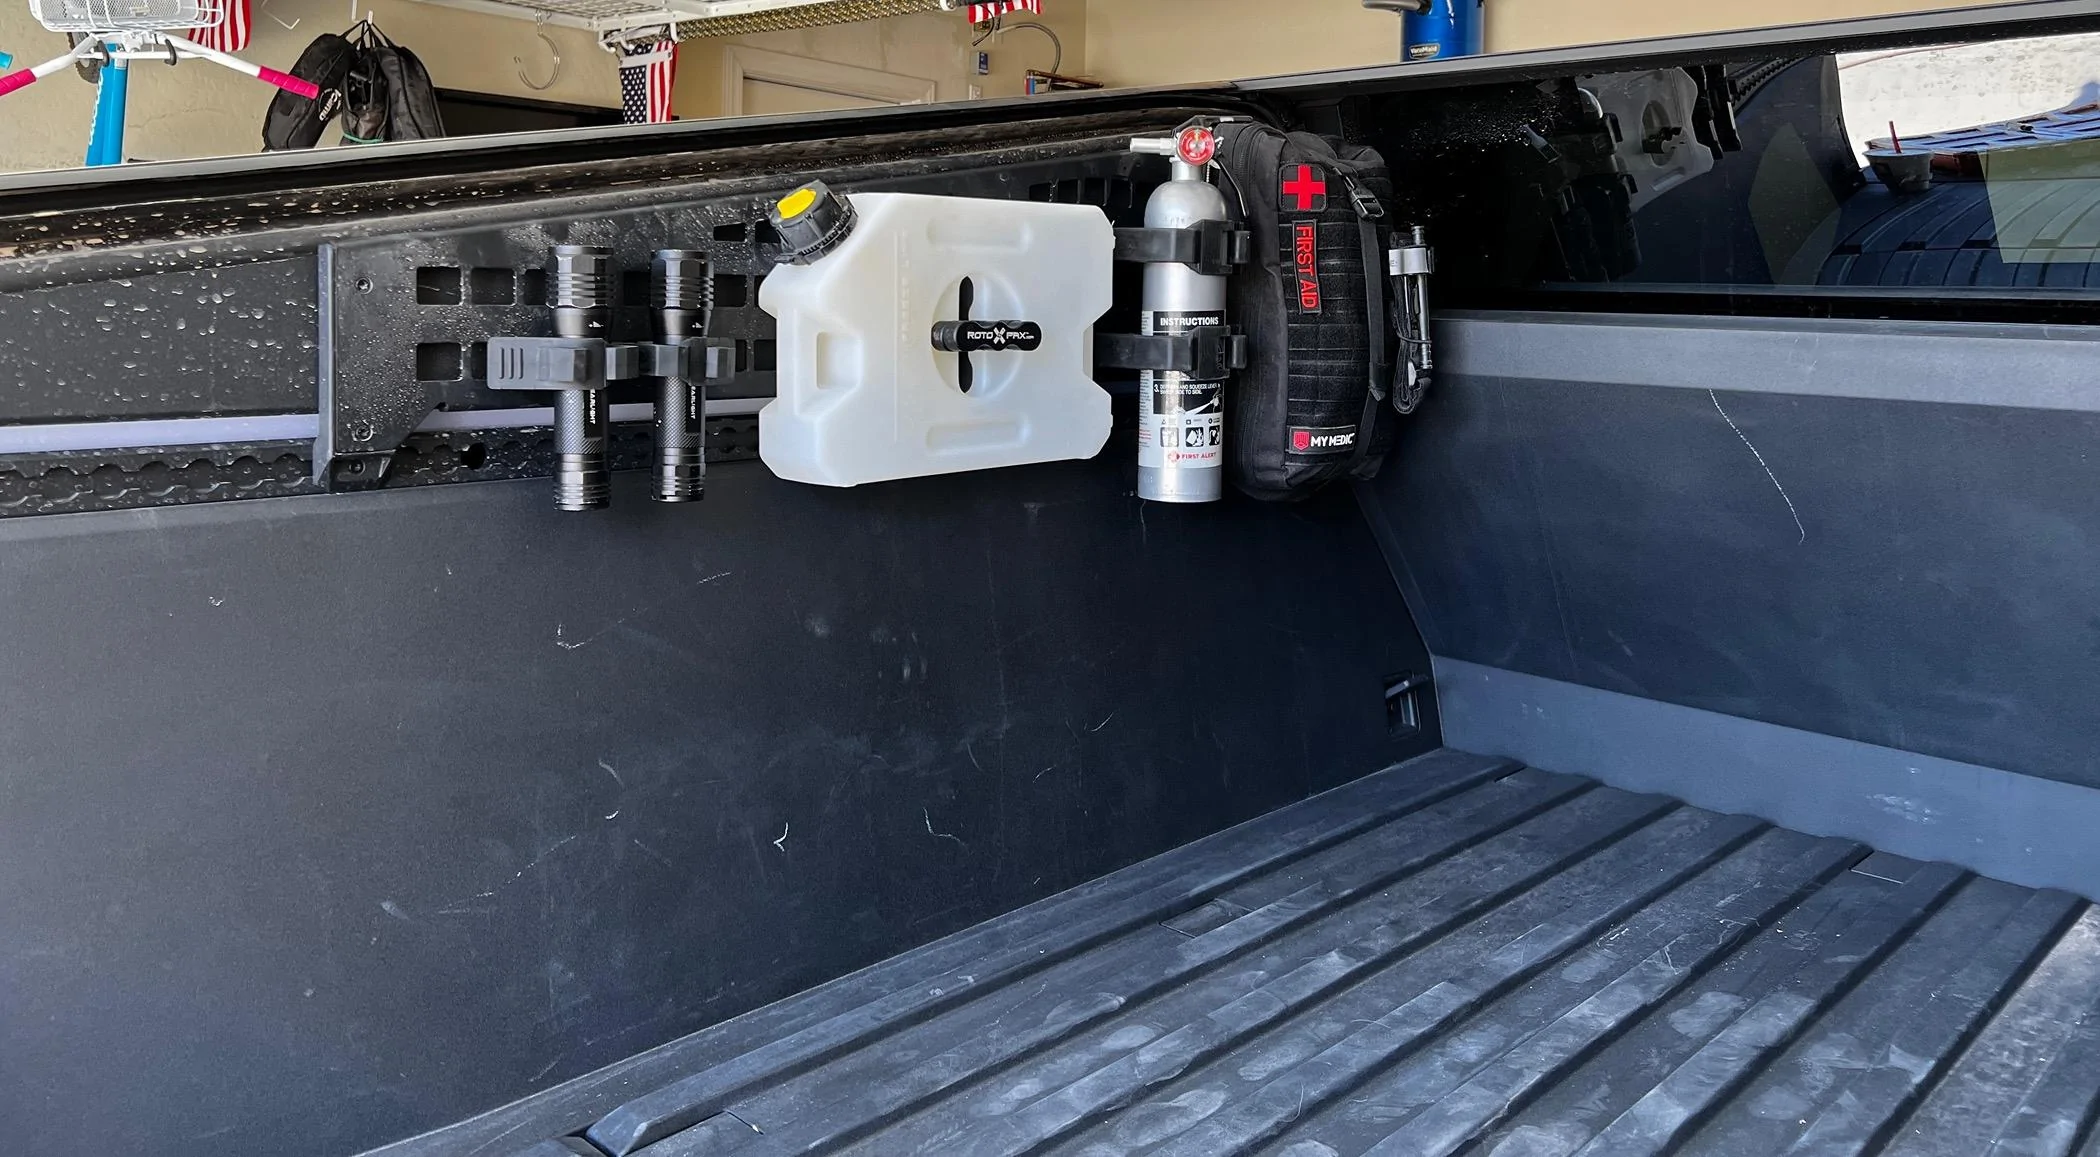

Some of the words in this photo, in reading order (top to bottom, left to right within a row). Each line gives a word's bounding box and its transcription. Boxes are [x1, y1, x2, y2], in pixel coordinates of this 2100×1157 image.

[1296, 226, 1314, 277] FIRST
[1300, 279, 1318, 308] AID
[1160, 316, 1219, 326] INSTRUCTIONS
[1311, 435, 1328, 447] MY
[1329, 432, 1355, 447] MEDIC
[1201, 451, 1217, 459] ALERT
